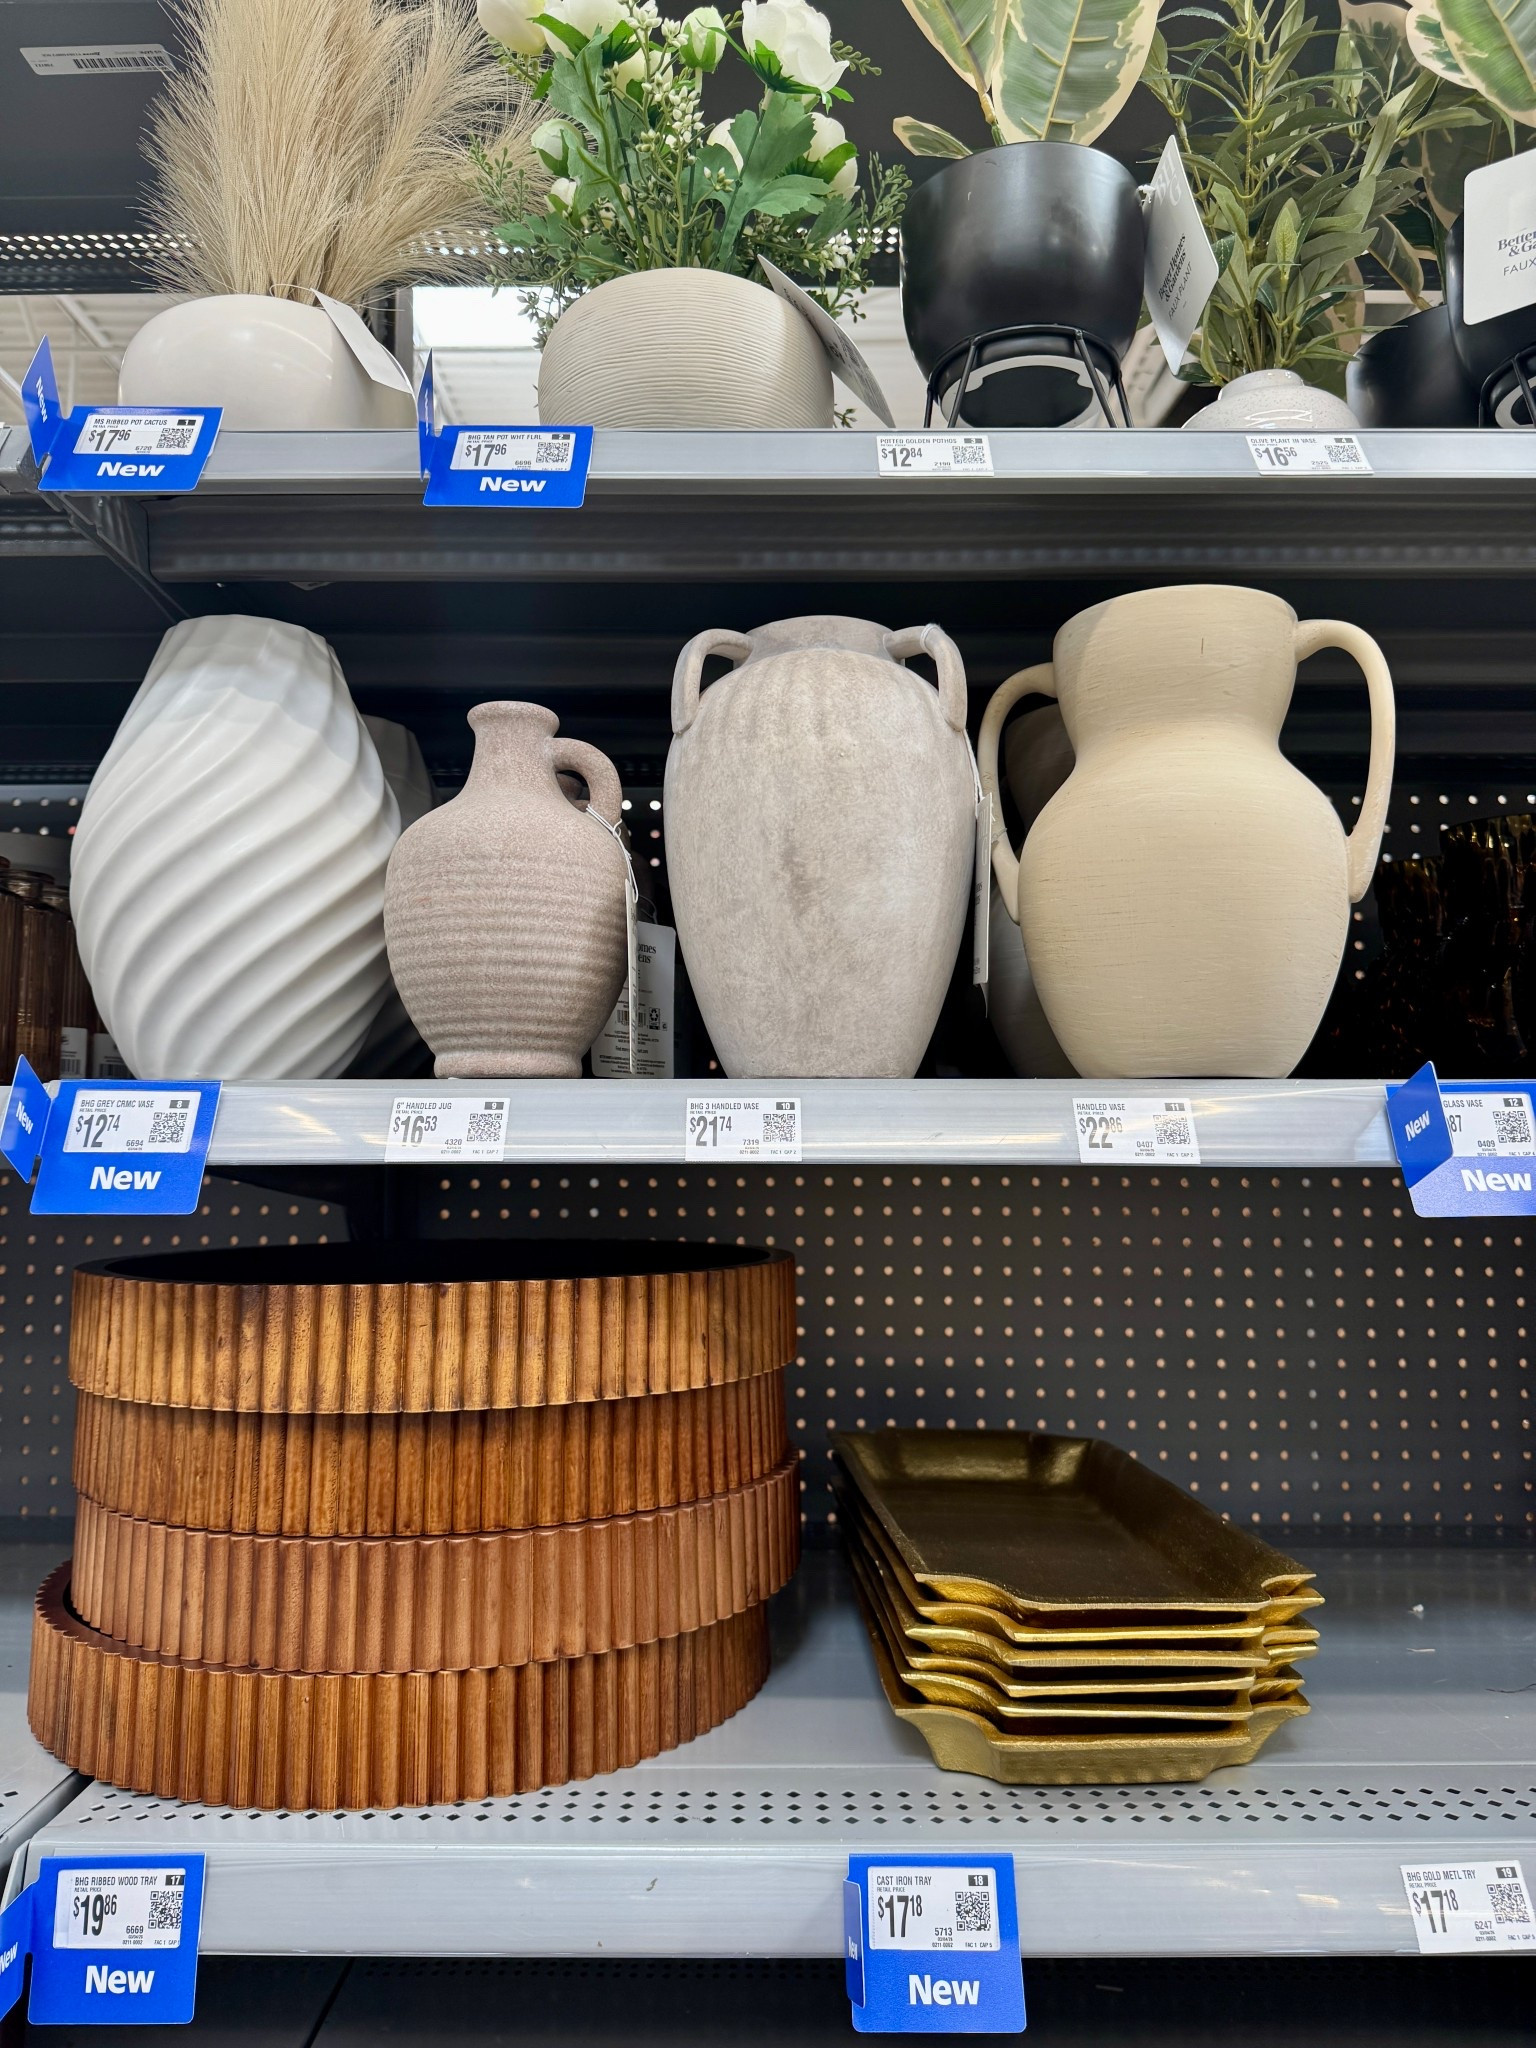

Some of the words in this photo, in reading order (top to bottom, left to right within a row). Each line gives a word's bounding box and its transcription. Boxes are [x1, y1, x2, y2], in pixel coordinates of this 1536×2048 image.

[1158, 268, 1172, 301] Better
[1170, 233, 1186, 271] Homes
[1168, 248, 1186, 293] Gardens
[1504, 257, 1536, 276] FAUX
[1168, 293, 1180, 320] FAUX
[1178, 261, 1192, 296] PLANT
[36, 376, 48, 423] New
[97, 462, 165, 476] New
[479, 477, 546, 492] New
[1443, 1100, 1464, 1108] GLASS
[1466, 1099, 1483, 1108] VASE
[1509, 1098, 1520, 1106] 12
[15, 1100, 34, 1134] New
[1404, 1110, 1430, 1142] New
[90, 1166, 161, 1190] New
[1461, 1169, 1532, 1192] New
[1406, 1872, 1421, 1881] BHG
[1423, 1871, 1441, 1881] GOLD
[1443, 1870, 1462, 1880] METL
[1462, 1870, 1476, 1879] TRY
[1502, 1868, 1512, 1878] 19
[75, 1877, 89, 1886] BHG
[91, 1877, 116, 1886] RIBBED
[118, 1876, 138, 1886] WOOD
[140, 1876, 157, 1885] TRAY
[171, 1876, 181, 1885] 17
[877, 1876, 893, 1886] CAST
[896, 1876, 912, 1886] IRON
[914, 1876, 932, 1886] TRAY
[973, 1876, 984, 1886] 18
[126, 1925, 144, 1934] 6669
[935, 1928, 953, 1936] 5713
[1475, 1921, 1492, 1929] 6247
[85, 1965, 155, 1994] New
[908, 1974, 980, 2006] New
